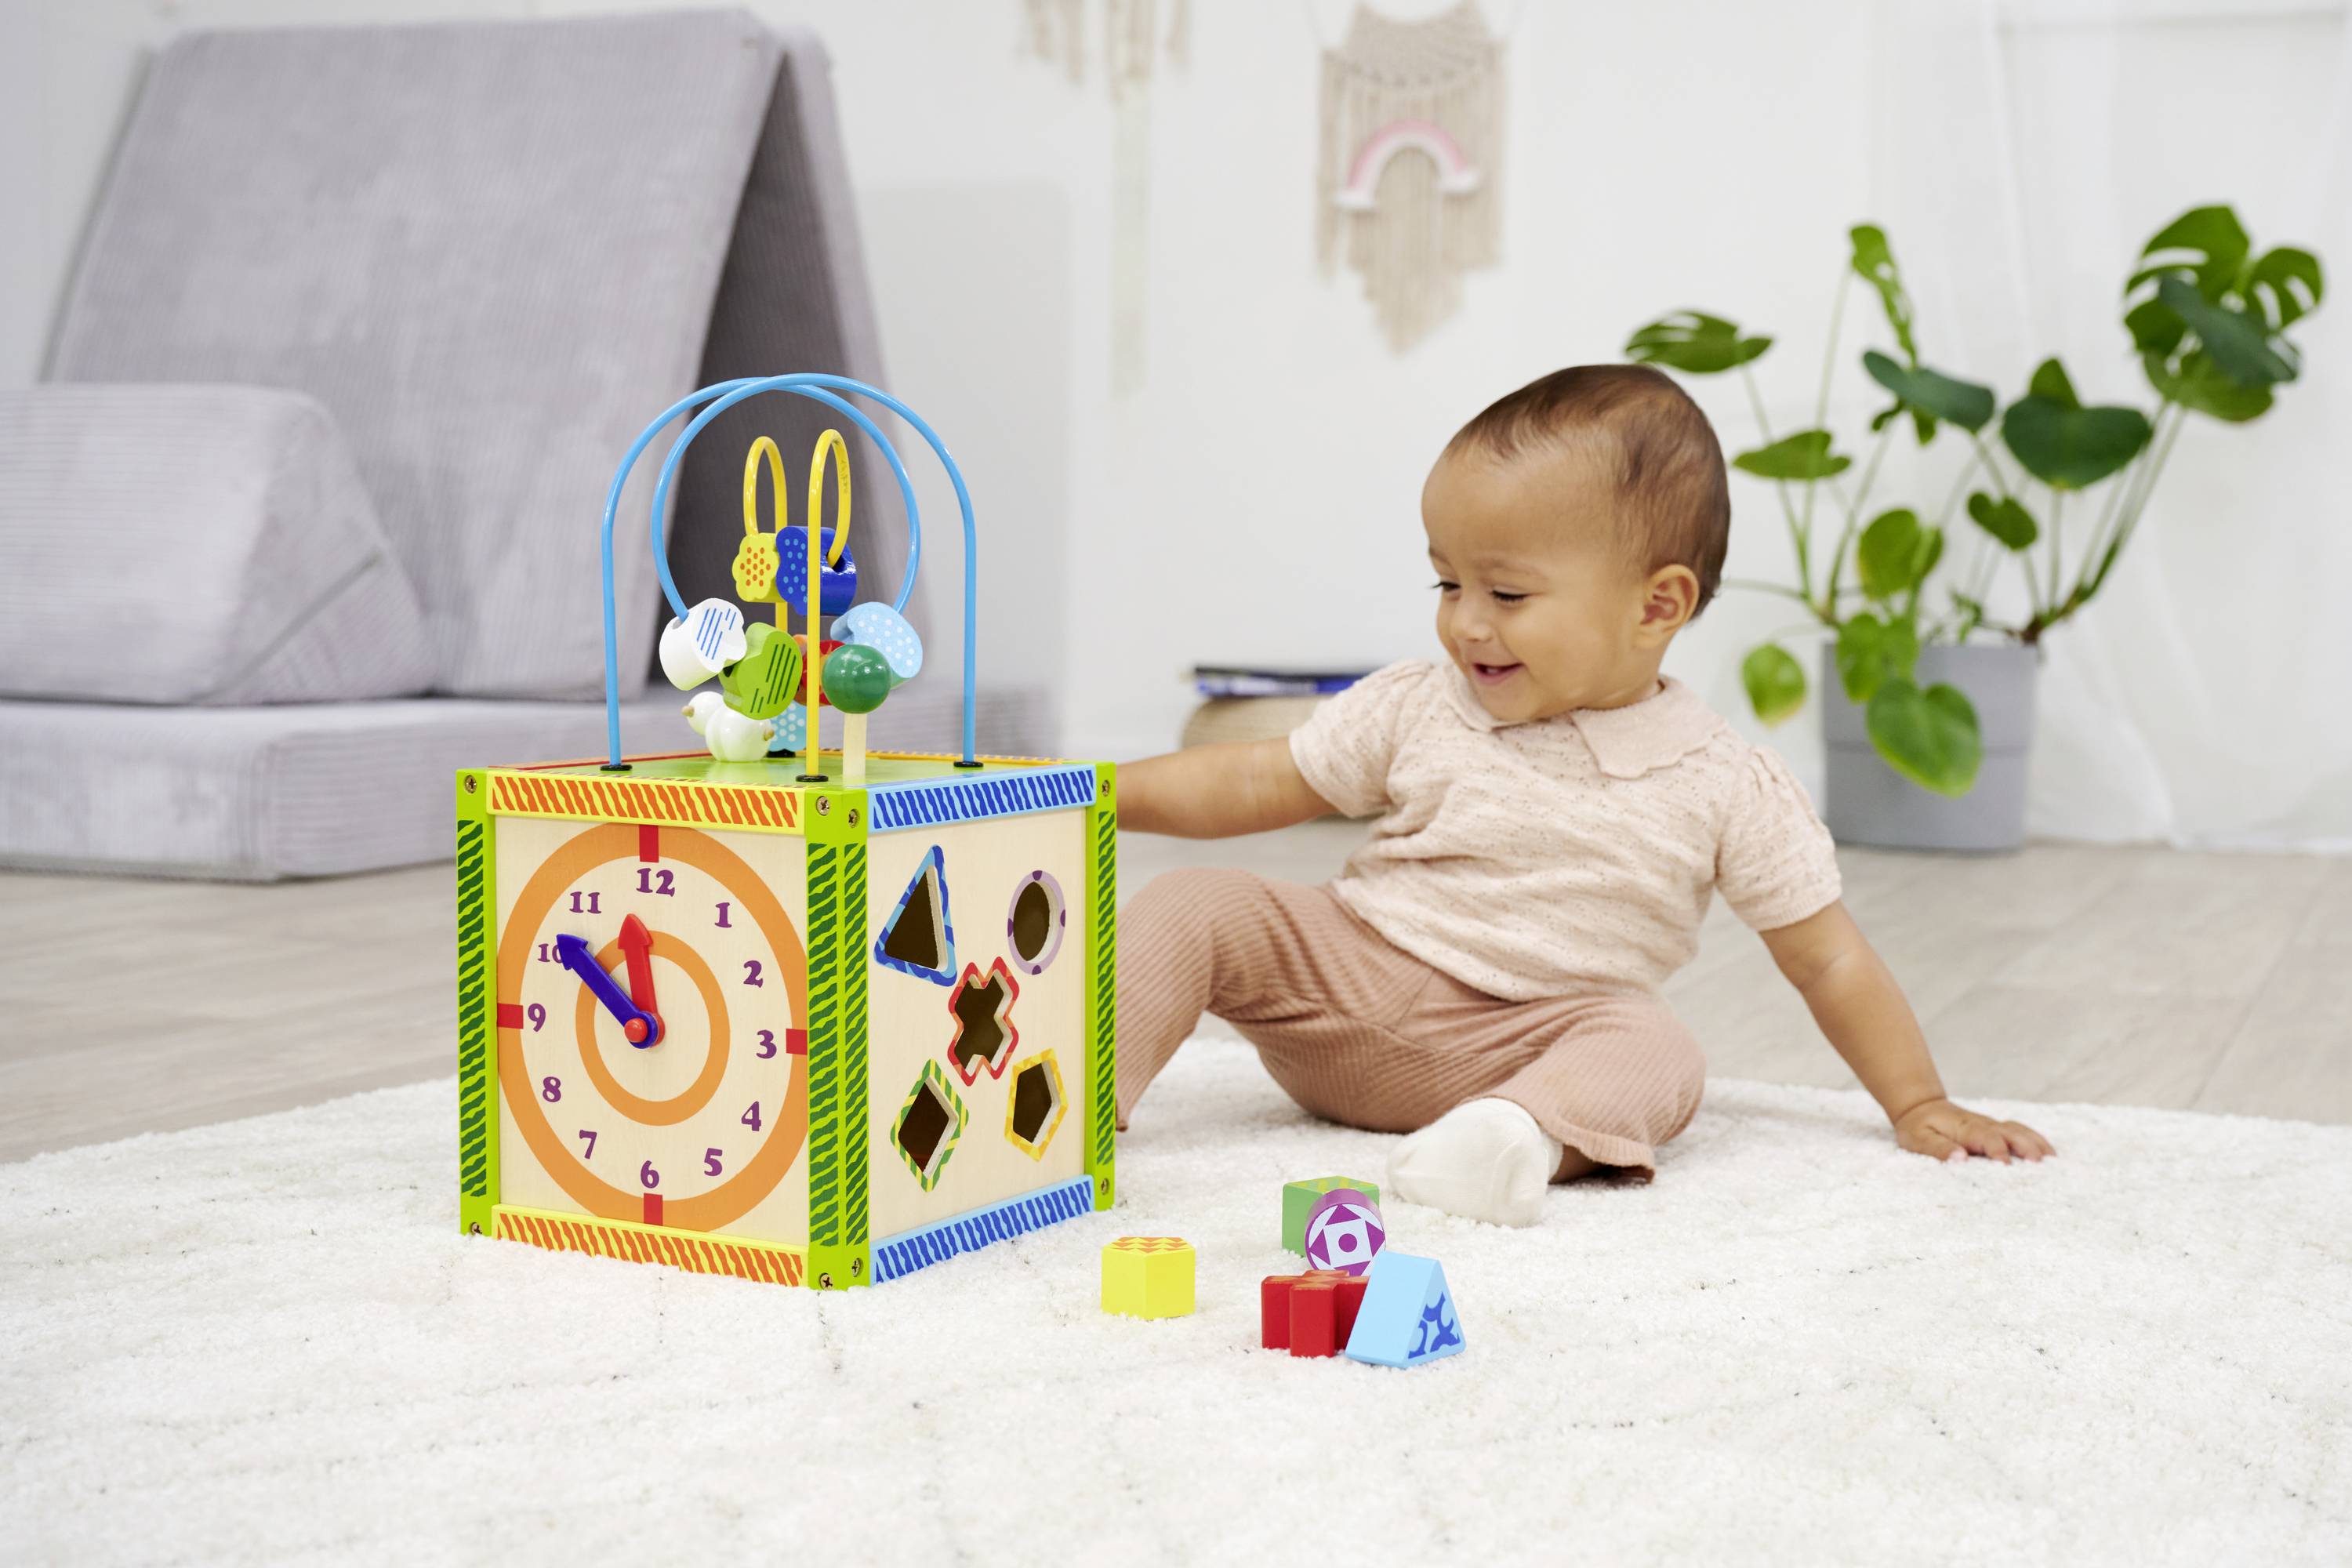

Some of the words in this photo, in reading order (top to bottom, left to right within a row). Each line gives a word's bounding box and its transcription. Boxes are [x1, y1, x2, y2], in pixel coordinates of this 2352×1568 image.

[636, 868, 676, 897] 12
[570, 891, 601, 914] 11
[714, 902, 731, 928] 1
[743, 960, 764, 988] 2
[528, 1003, 546, 1032] 9
[756, 1029, 777, 1059] 3
[542, 1076, 561, 1102] 8
[741, 1101, 761, 1132] 4
[579, 1129, 597, 1159] 7
[640, 1160, 660, 1189] 6
[703, 1147, 723, 1176] 5
